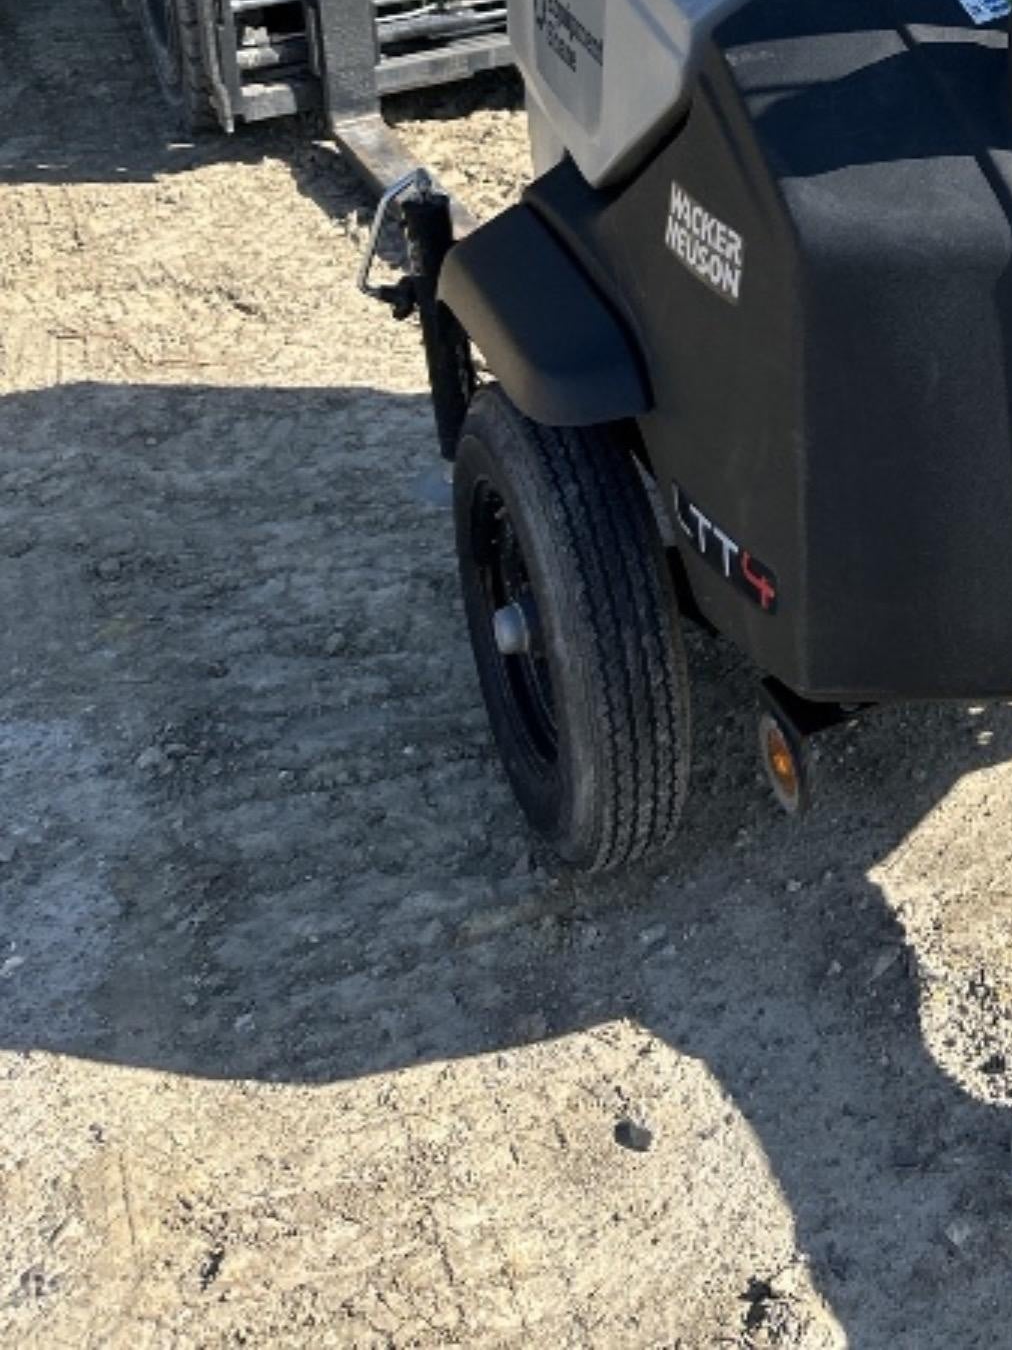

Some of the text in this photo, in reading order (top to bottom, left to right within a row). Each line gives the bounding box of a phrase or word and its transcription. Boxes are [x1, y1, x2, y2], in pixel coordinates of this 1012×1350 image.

[664, 214, 741, 298] NEUSON
[670, 179, 742, 267] WACKER
[671, 481, 776, 611] LTT4
